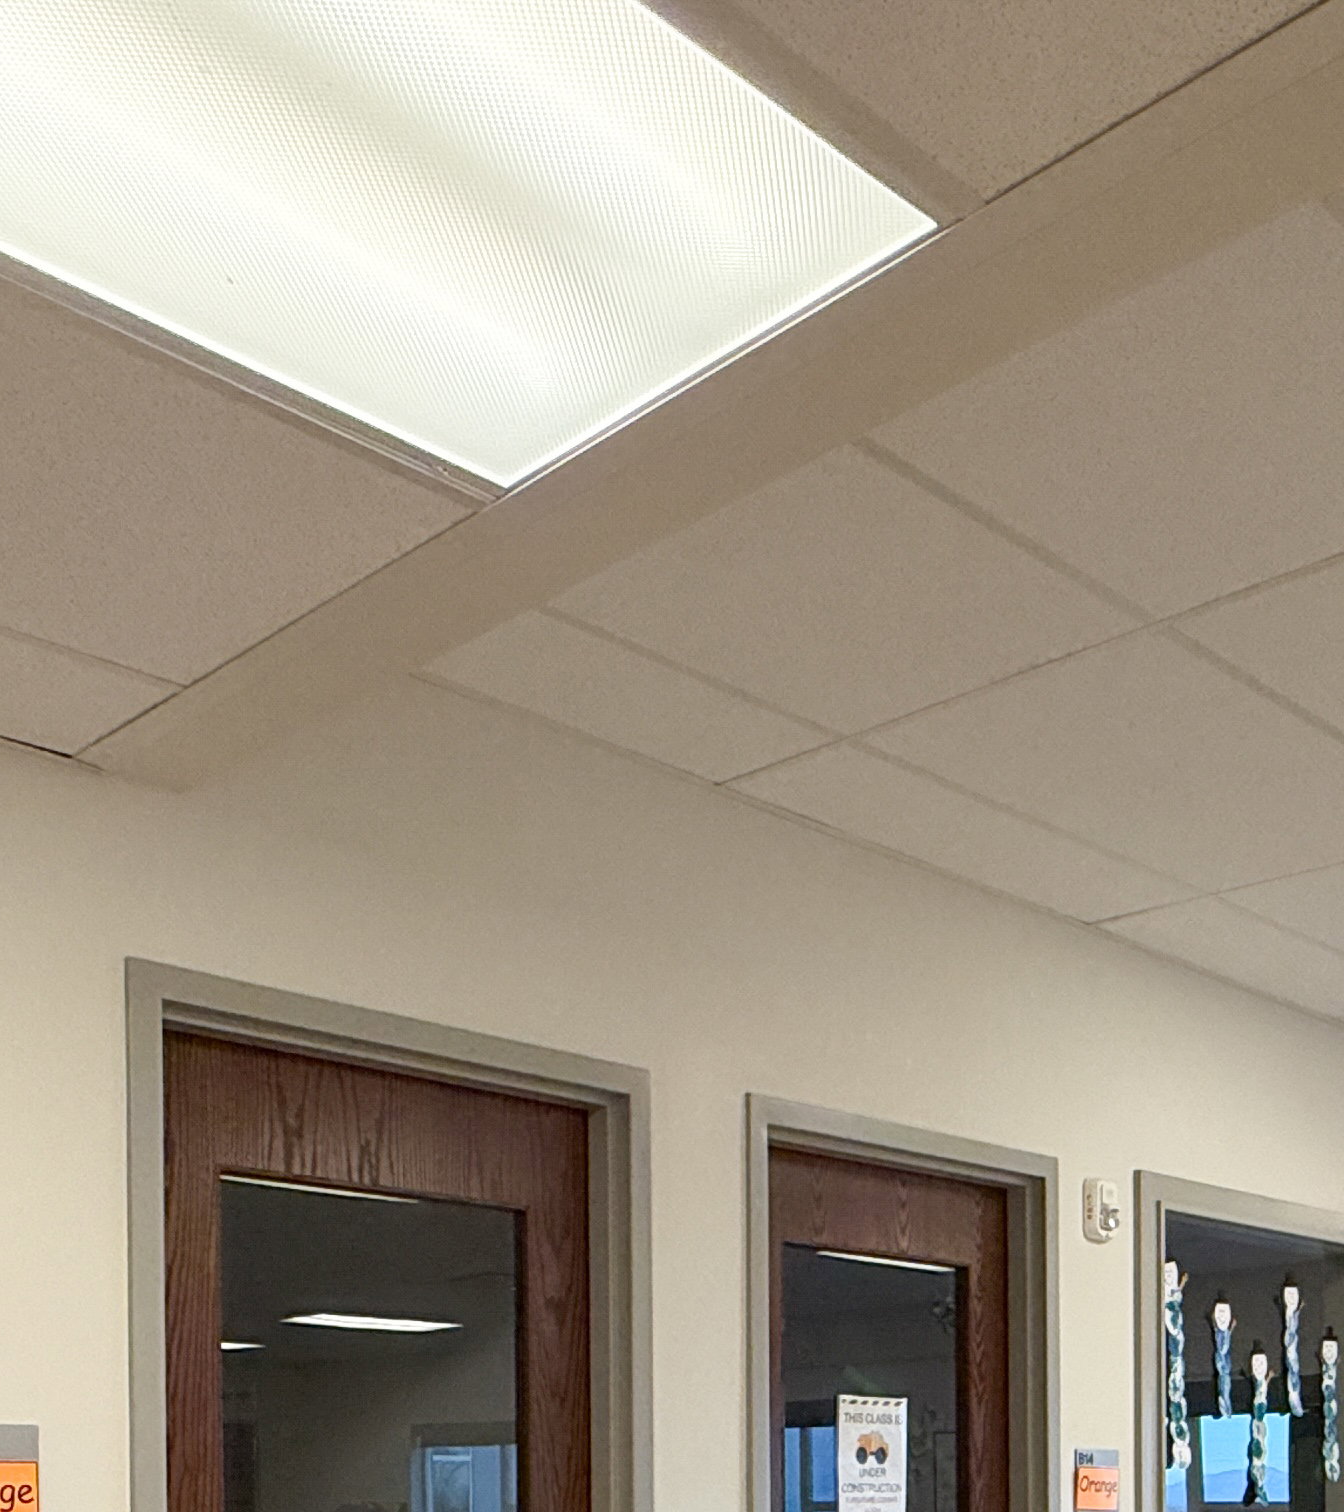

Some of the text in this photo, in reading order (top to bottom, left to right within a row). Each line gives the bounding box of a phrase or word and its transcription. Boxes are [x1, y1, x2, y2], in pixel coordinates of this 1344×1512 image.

[844, 1412, 864, 1424] THIS
[865, 1412, 893, 1425] CLASS
[859, 1467, 887, 1478] UNDER
[841, 1482, 903, 1494] CONSTRUCTION
[1079, 1475, 1118, 1498] Orange
